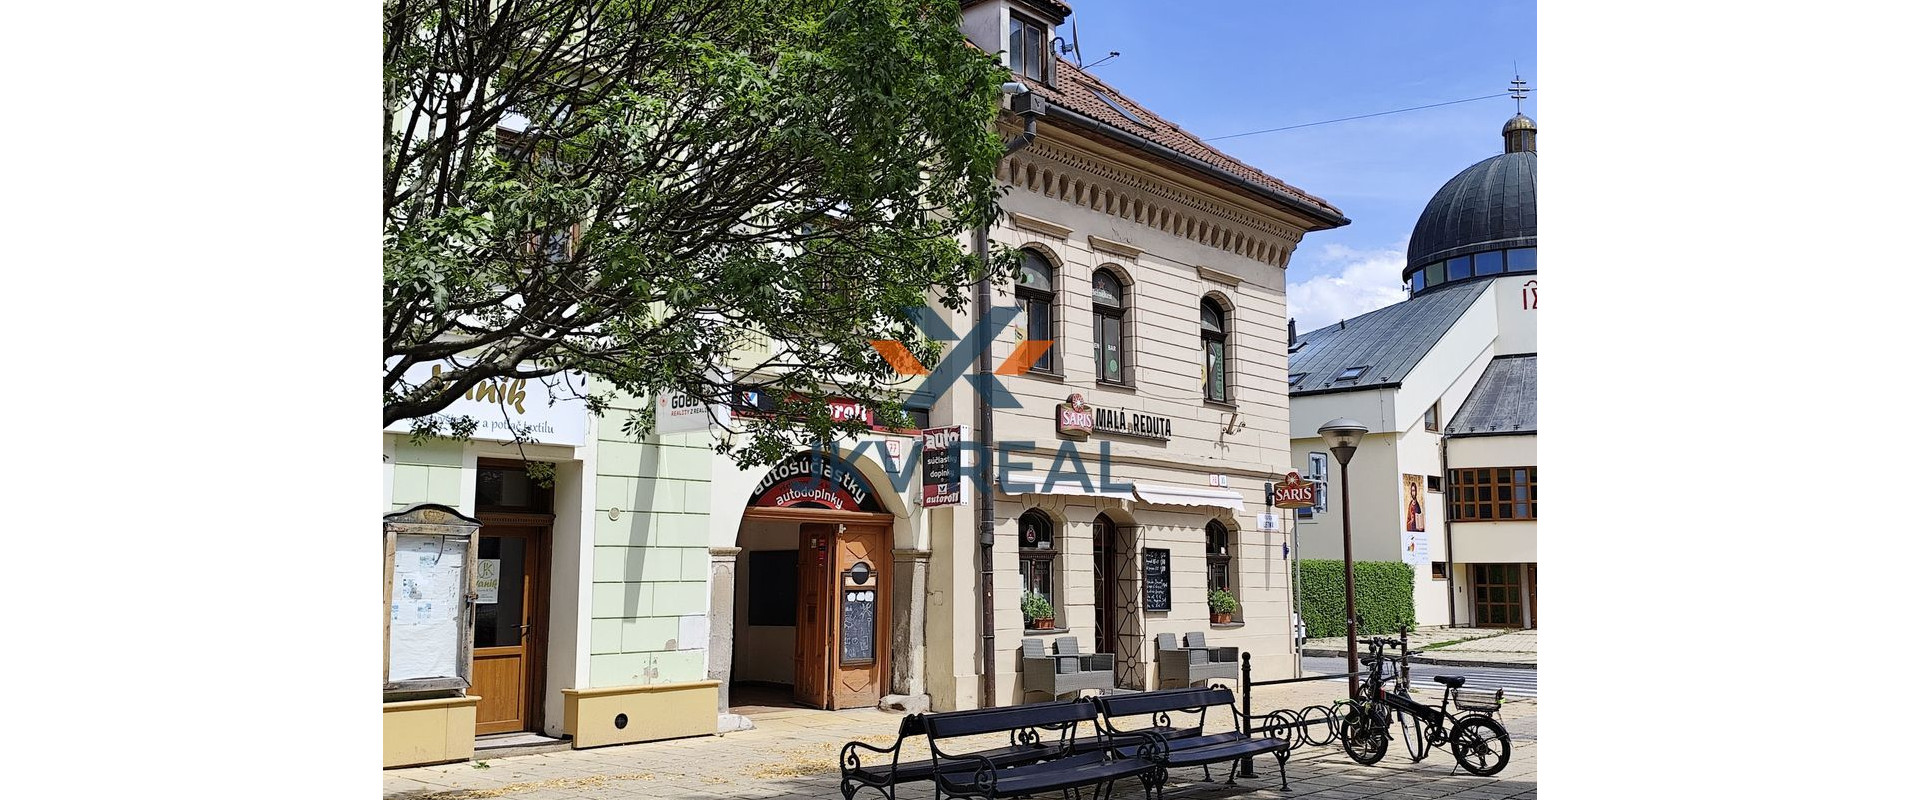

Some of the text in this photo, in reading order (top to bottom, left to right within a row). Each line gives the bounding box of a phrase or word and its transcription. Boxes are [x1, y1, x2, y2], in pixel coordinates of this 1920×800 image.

[491, 418, 521, 431] potlač
[1095, 407, 1172, 437] MALÁ REDUTA
[924, 429, 960, 450] auto
[754, 455, 866, 505] autosúčiastky
[775, 487, 843, 509] autodoplnky
